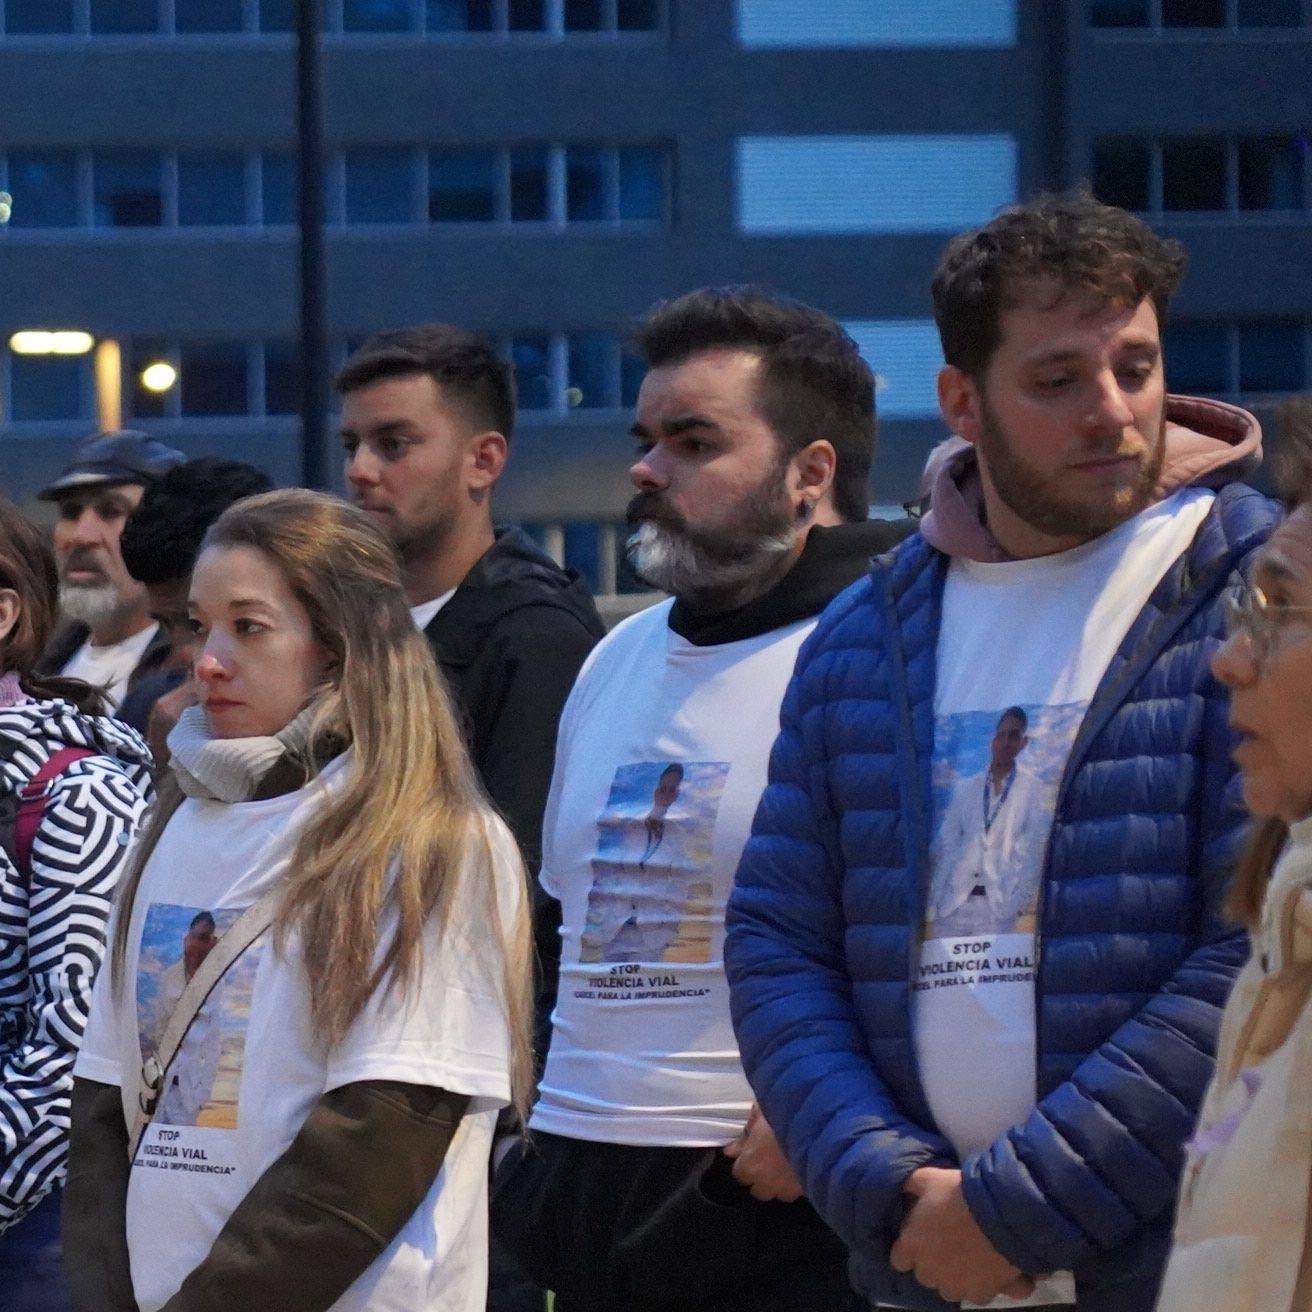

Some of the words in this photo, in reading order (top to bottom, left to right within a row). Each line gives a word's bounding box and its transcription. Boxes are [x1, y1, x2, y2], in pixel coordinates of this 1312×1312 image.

[953, 942, 992, 955] STOP
[996, 956, 1033, 969] VIAL
[610, 964, 641, 975] STOP
[648, 976, 680, 987] VIAL
[978, 972, 1035, 984] IMPRUDE
[182, 1147, 208, 1160] VIAL
